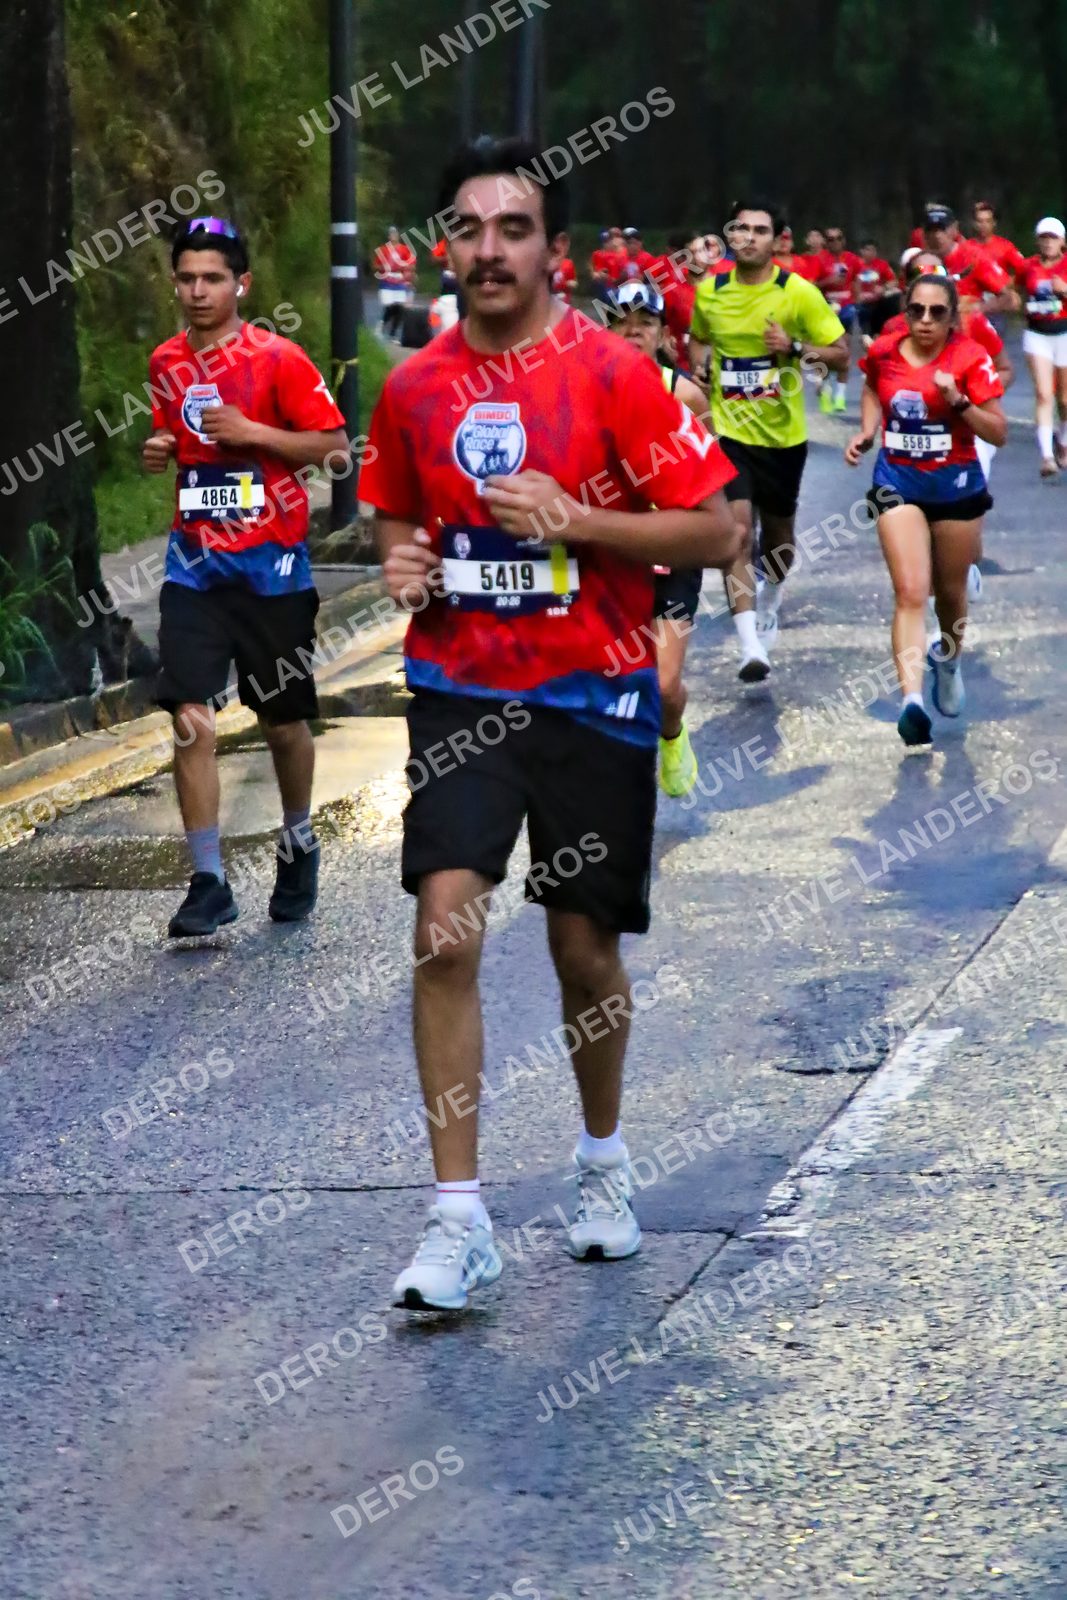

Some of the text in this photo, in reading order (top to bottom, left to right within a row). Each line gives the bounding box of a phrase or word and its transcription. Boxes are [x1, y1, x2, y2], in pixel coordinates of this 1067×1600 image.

[464, 437, 495, 450] Race
[902, 435, 931, 449] 5583
[201, 488, 238, 506] 4864
[480, 563, 535, 591] 5419
